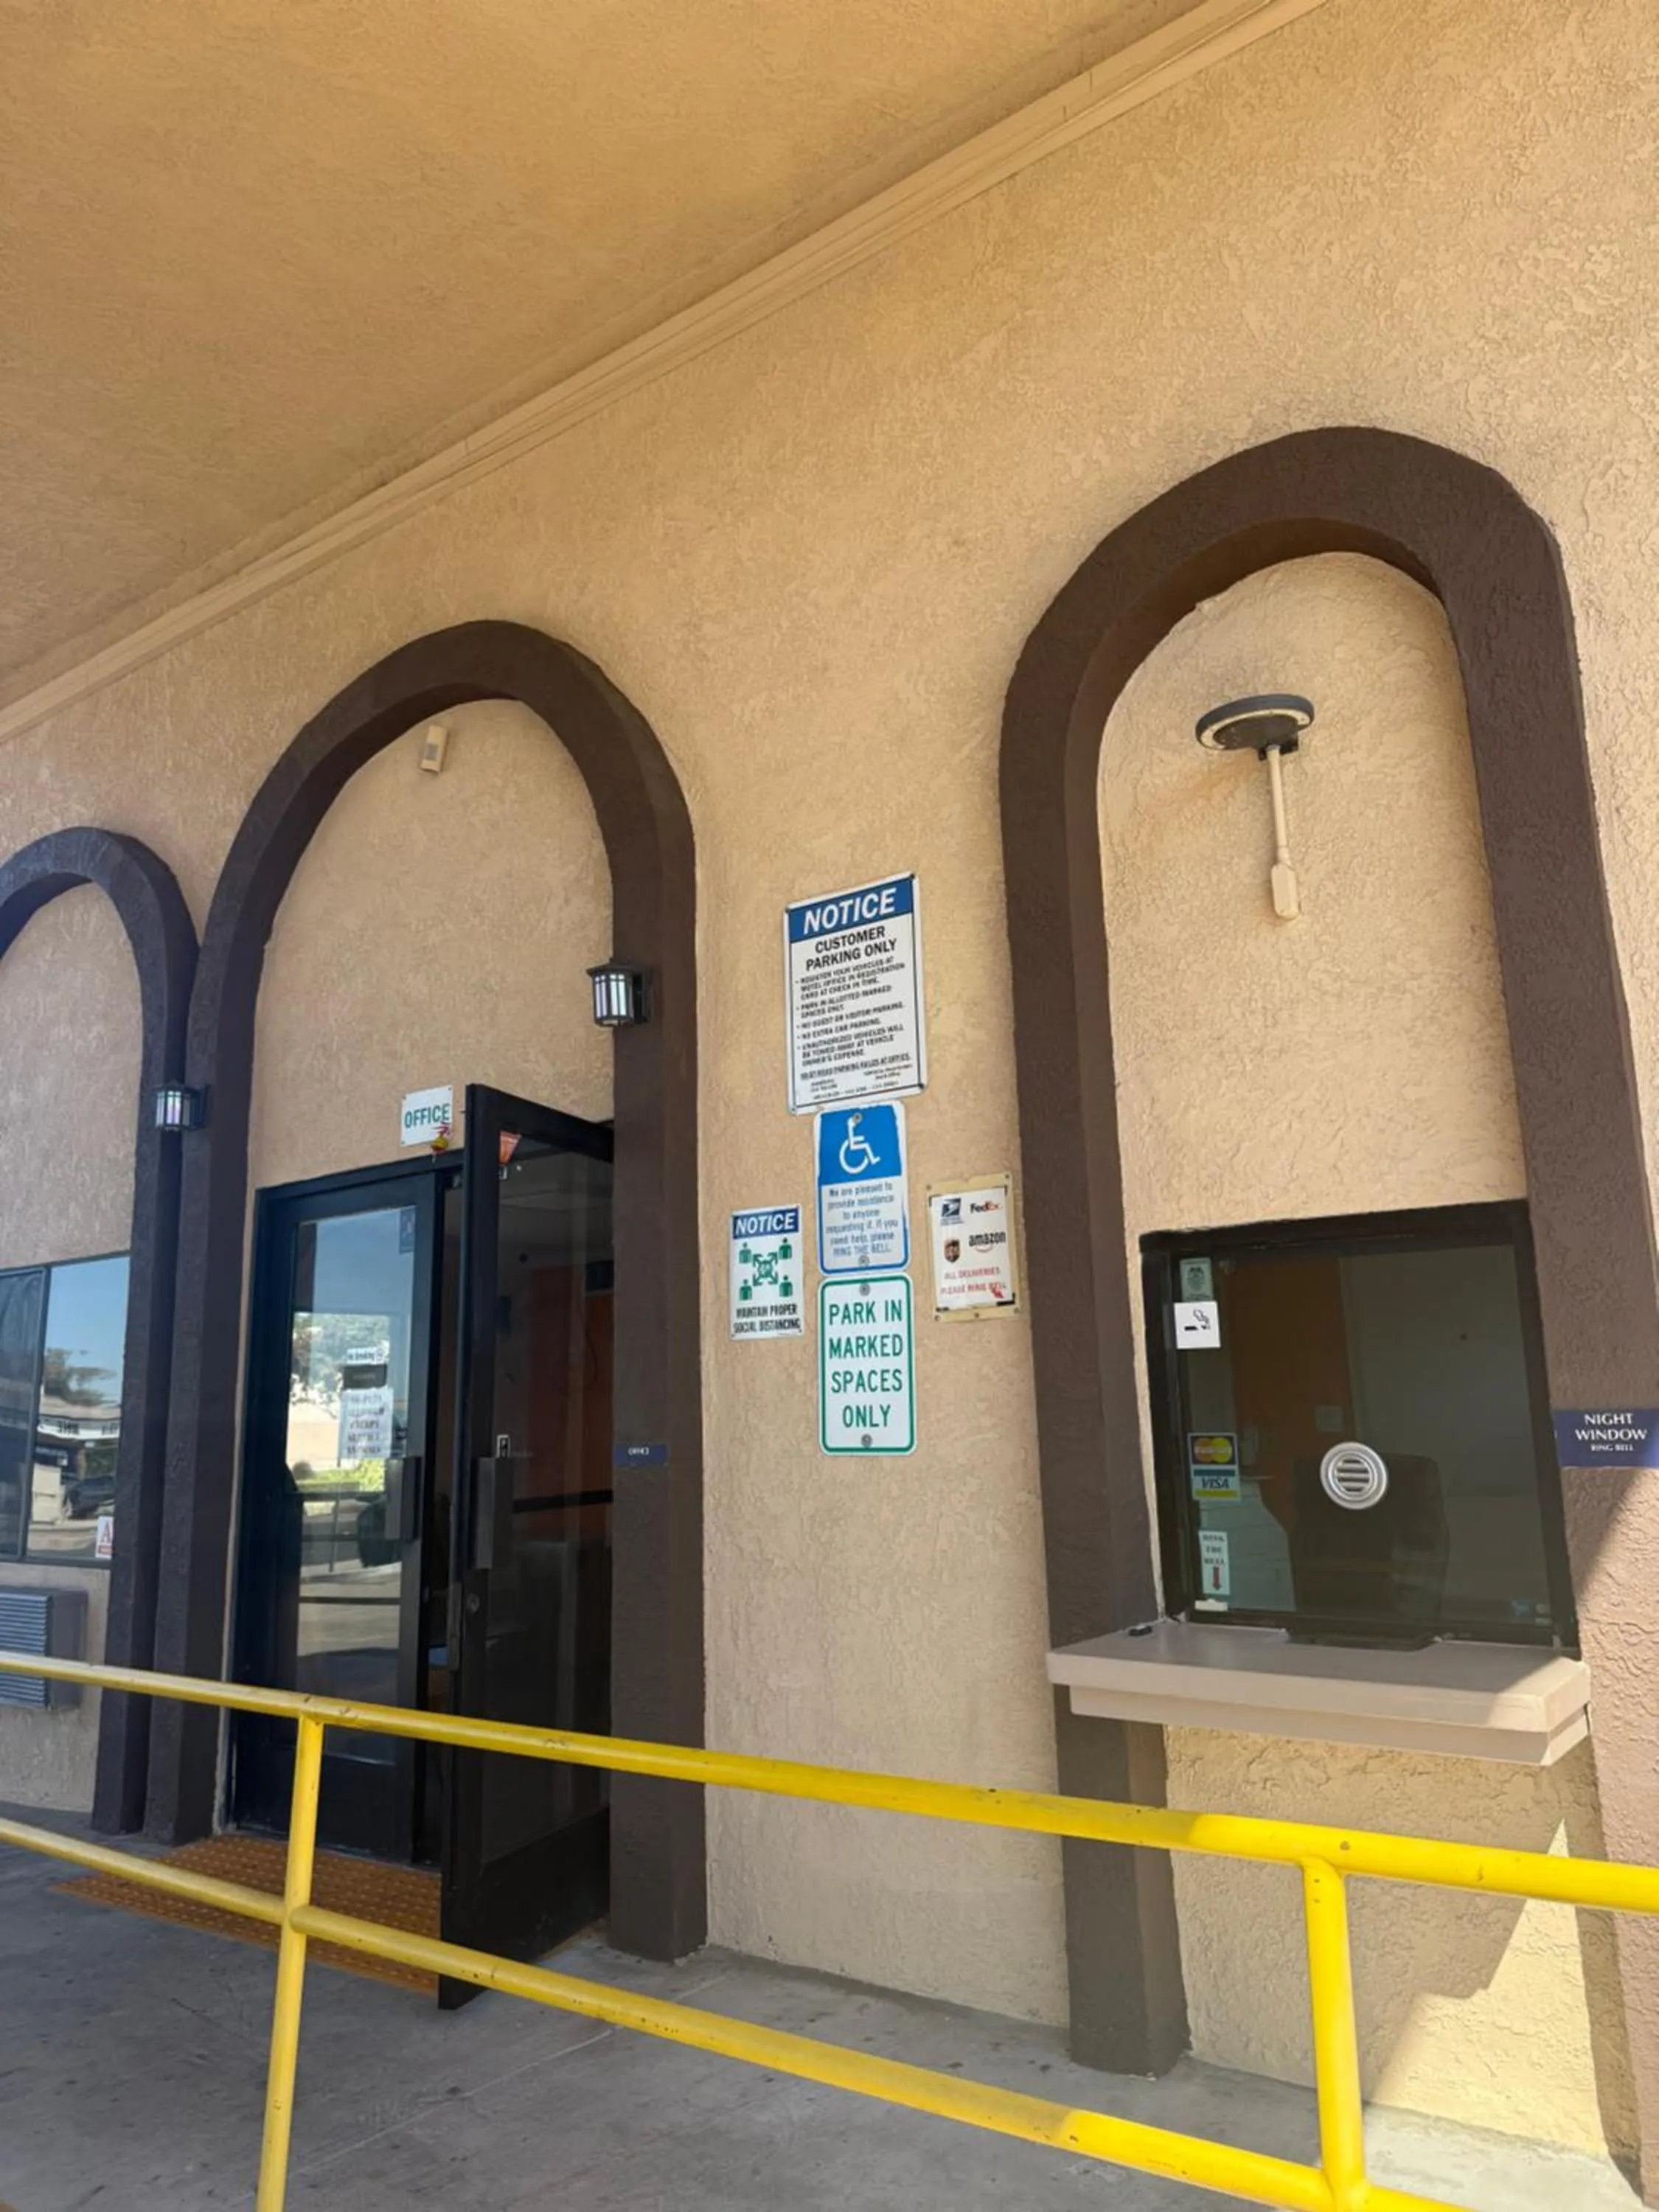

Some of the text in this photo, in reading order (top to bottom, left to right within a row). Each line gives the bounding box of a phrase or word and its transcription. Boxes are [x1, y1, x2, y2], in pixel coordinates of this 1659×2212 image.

[803, 887, 897, 935] NOTICE
[815, 925, 885, 954] CUSTOMER
[805, 938, 897, 972] PARKING ONLY
[823, 975, 846, 987] OFFICE
[801, 990, 818, 1001] CARD
[820, 987, 827, 996] AT
[829, 983, 851, 995] CHECK
[801, 1001, 818, 1010] PARK
[813, 1027, 833, 1039] EXTRA
[835, 1023, 848, 1034] CAR
[857, 1039, 865, 1047] AT
[866, 1033, 894, 1046] VEHICLE
[404, 1103, 451, 1129] OFFICE
[841, 1187, 853, 1195] are
[855, 1183, 883, 1196] pleased
[884, 1180, 893, 1191] to
[827, 1194, 894, 1212] provide assistance
[970, 1201, 999, 1214] FedEx
[843, 1209, 880, 1220] to anyone
[734, 1211, 796, 1235] NOTICE
[825, 1222, 864, 1234] requesting
[883, 1219, 898, 1230] you
[830, 1235, 849, 1245] need
[870, 1232, 894, 1242] please
[968, 1231, 1006, 1247] amazon
[958, 1266, 1001, 1279] DELIVERIES
[940, 1284, 965, 1295] PLEASE
[967, 1282, 987, 1292] RING
[770, 1303, 797, 1317] PROPER
[829, 1299, 902, 1326] PARK IN
[733, 1318, 801, 1334] SOCIAL DISTANCING
[829, 1334, 903, 1359] MARKED
[831, 1368, 902, 1394] SPACES
[842, 1404, 891, 1428] ONLY
[1584, 1413, 1633, 1425] NIGHT
[1574, 1428, 1648, 1441] WINDOW
[1590, 1444, 1613, 1452] RING
[1201, 1476, 1230, 1489] VISA
